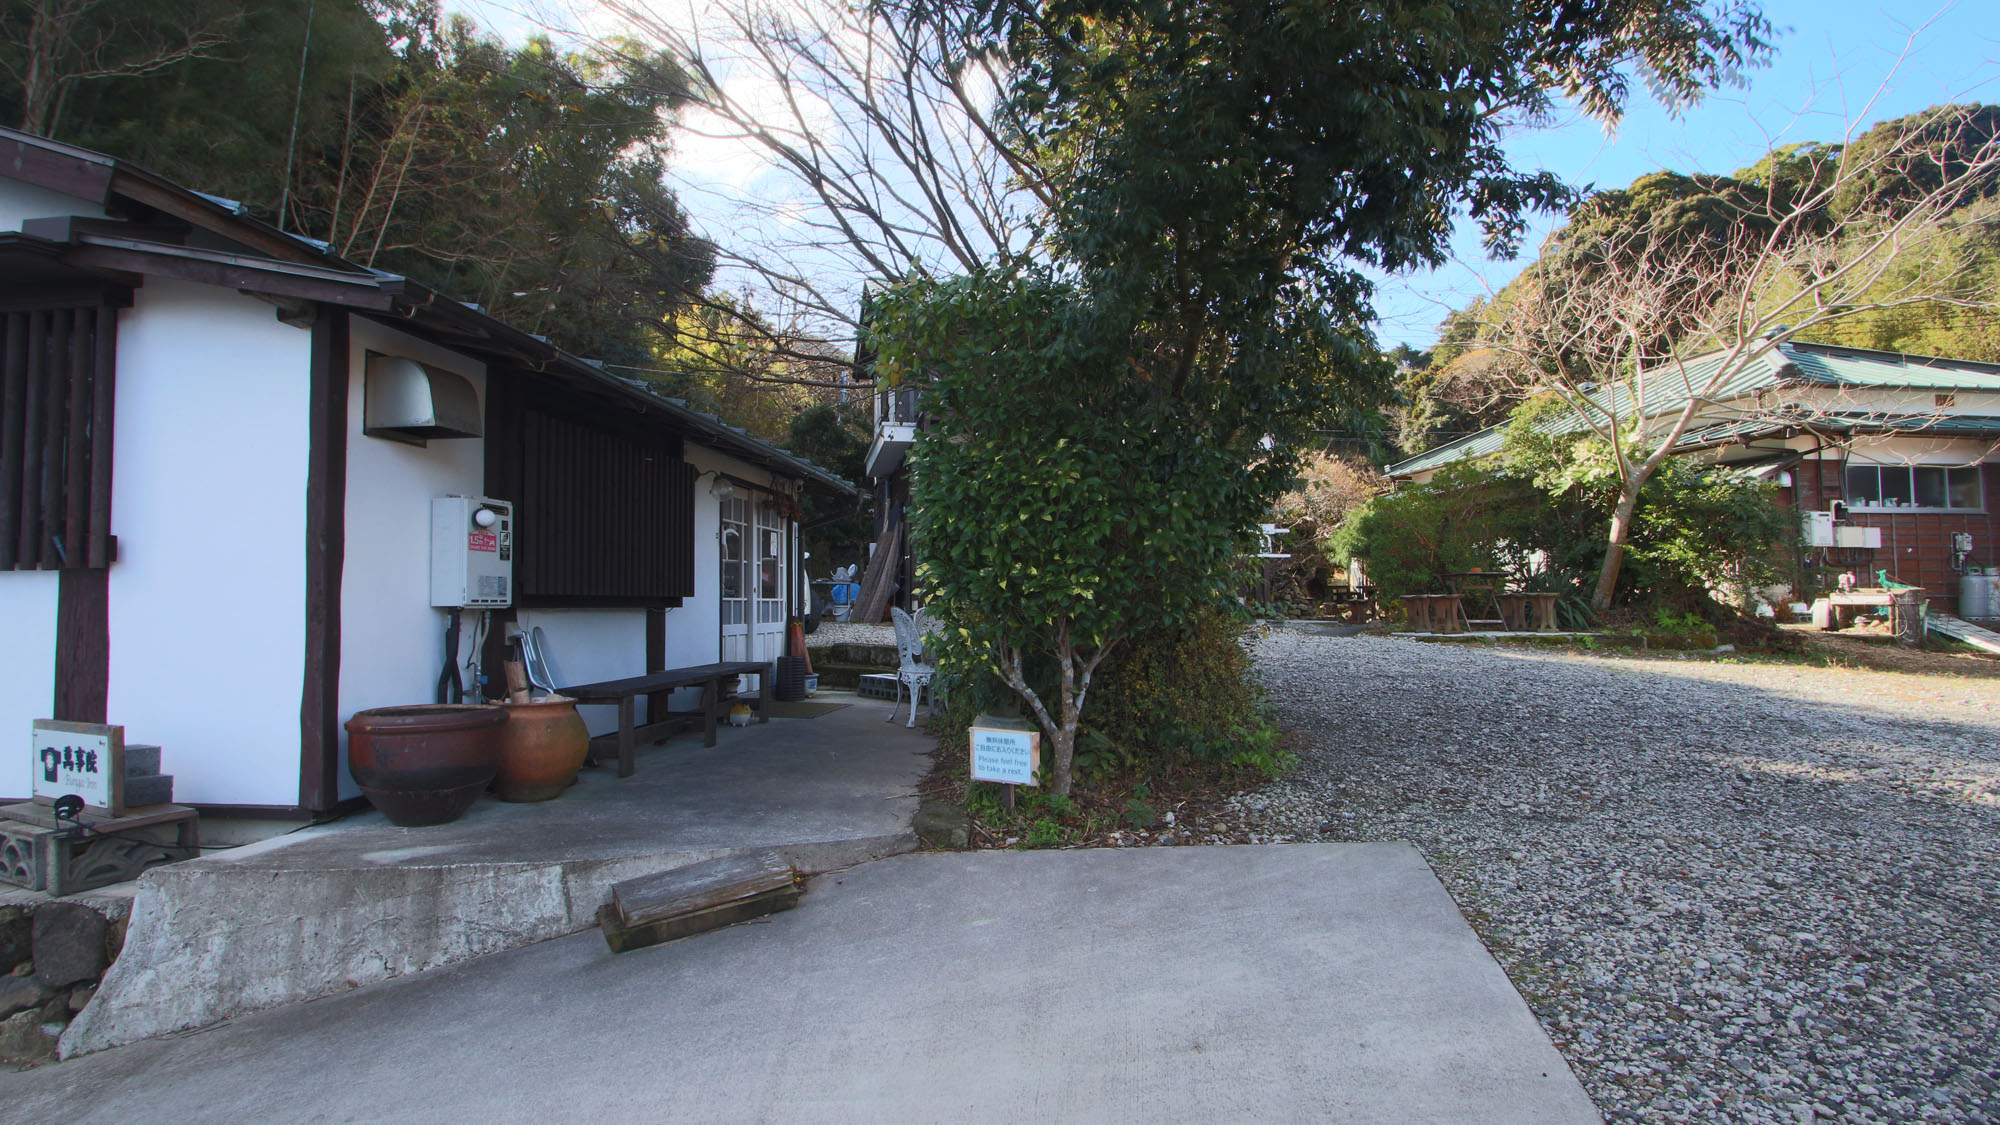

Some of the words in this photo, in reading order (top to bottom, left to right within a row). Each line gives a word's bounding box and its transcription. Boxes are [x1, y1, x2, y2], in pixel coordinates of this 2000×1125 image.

[978, 754, 999, 764] Please
[1014, 759, 1027, 767] free
[987, 765, 1000, 773] take
